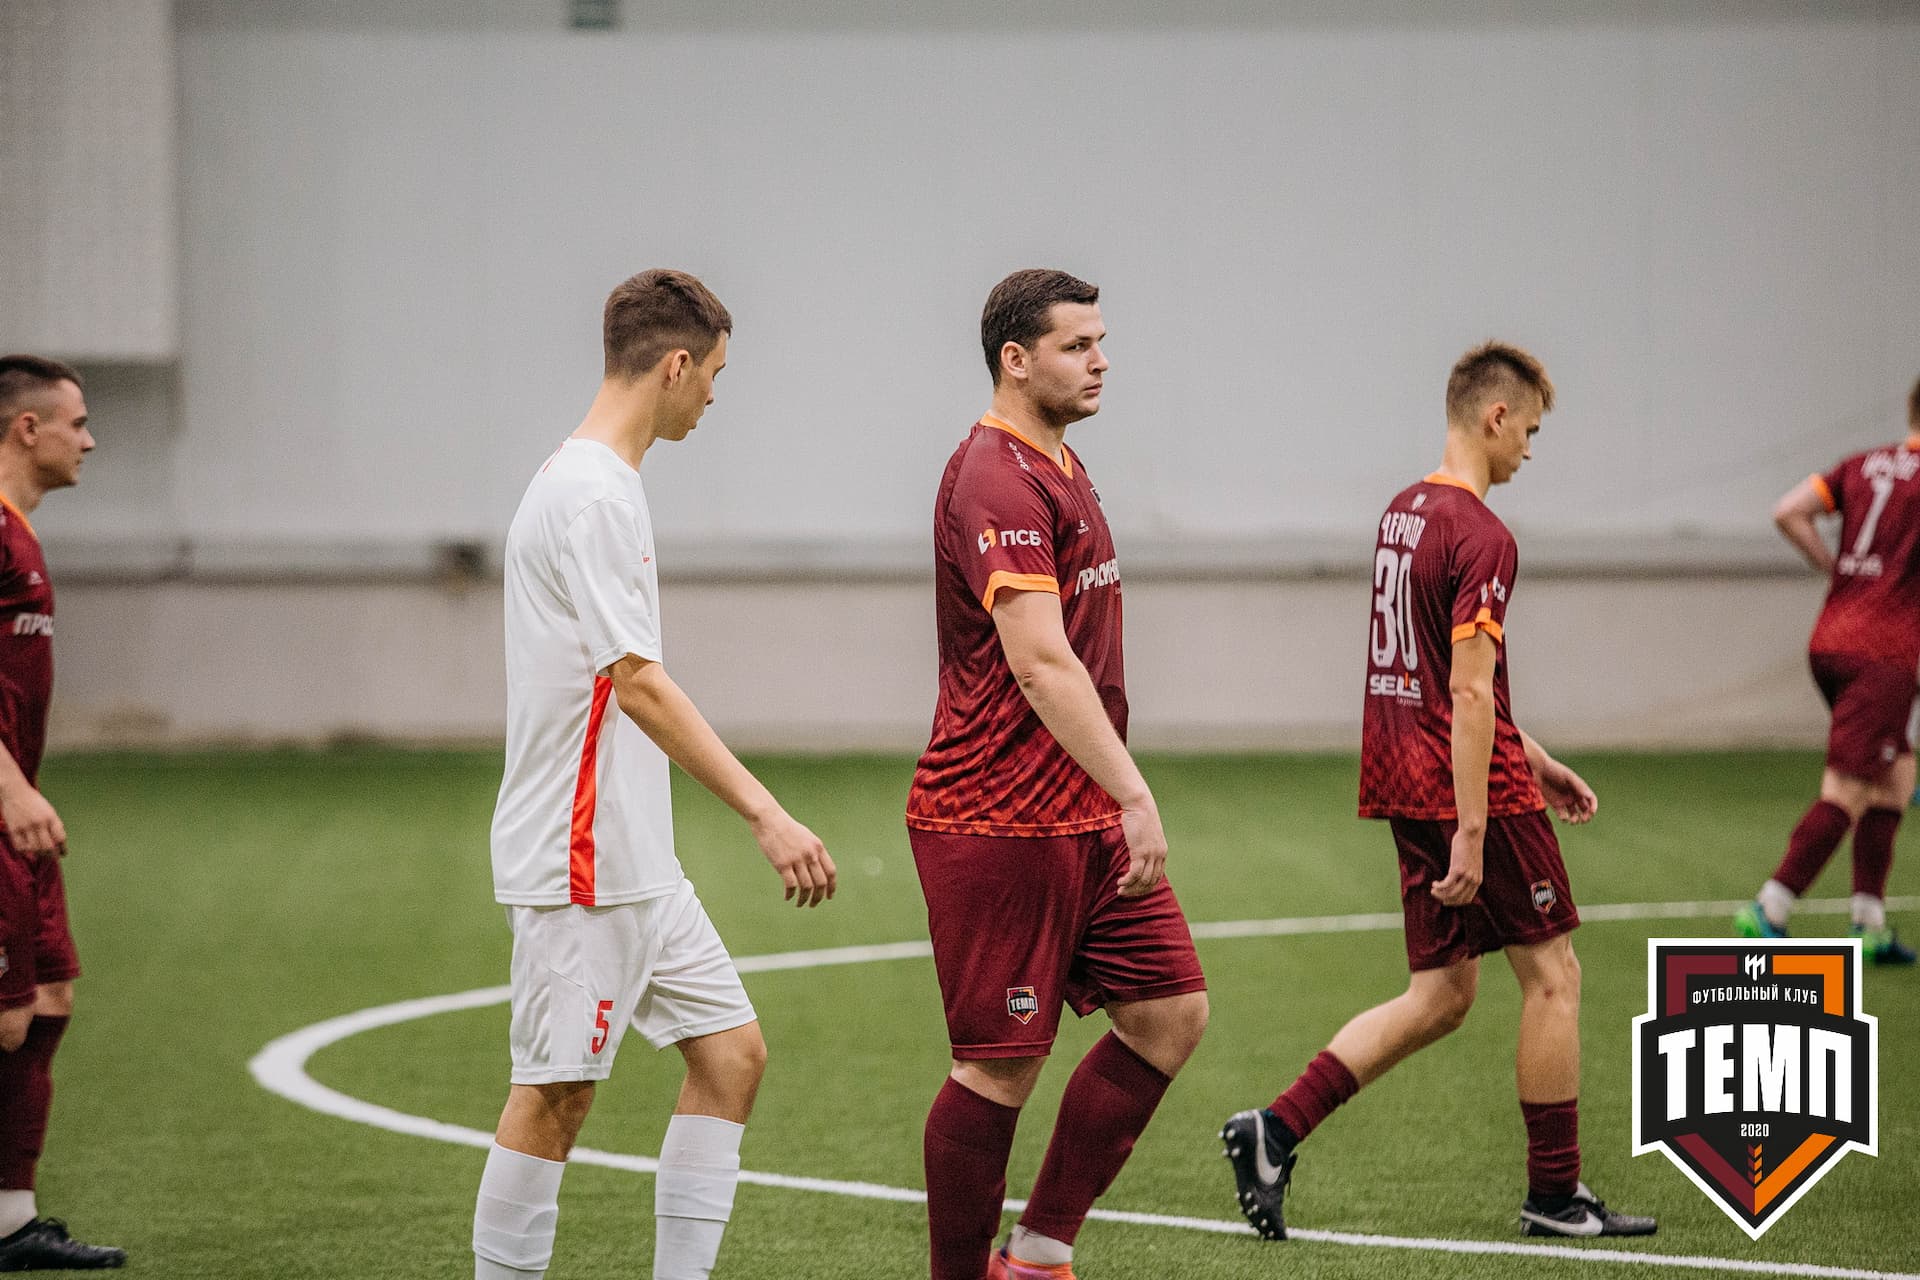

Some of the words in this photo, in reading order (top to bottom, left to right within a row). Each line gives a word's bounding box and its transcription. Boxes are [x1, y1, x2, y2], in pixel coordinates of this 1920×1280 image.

[1000, 529, 1042, 547] ПСБ
[1372, 548, 1418, 671] 30
[1010, 997, 1036, 1012] ТЕМП
[590, 999, 615, 1056] 5
